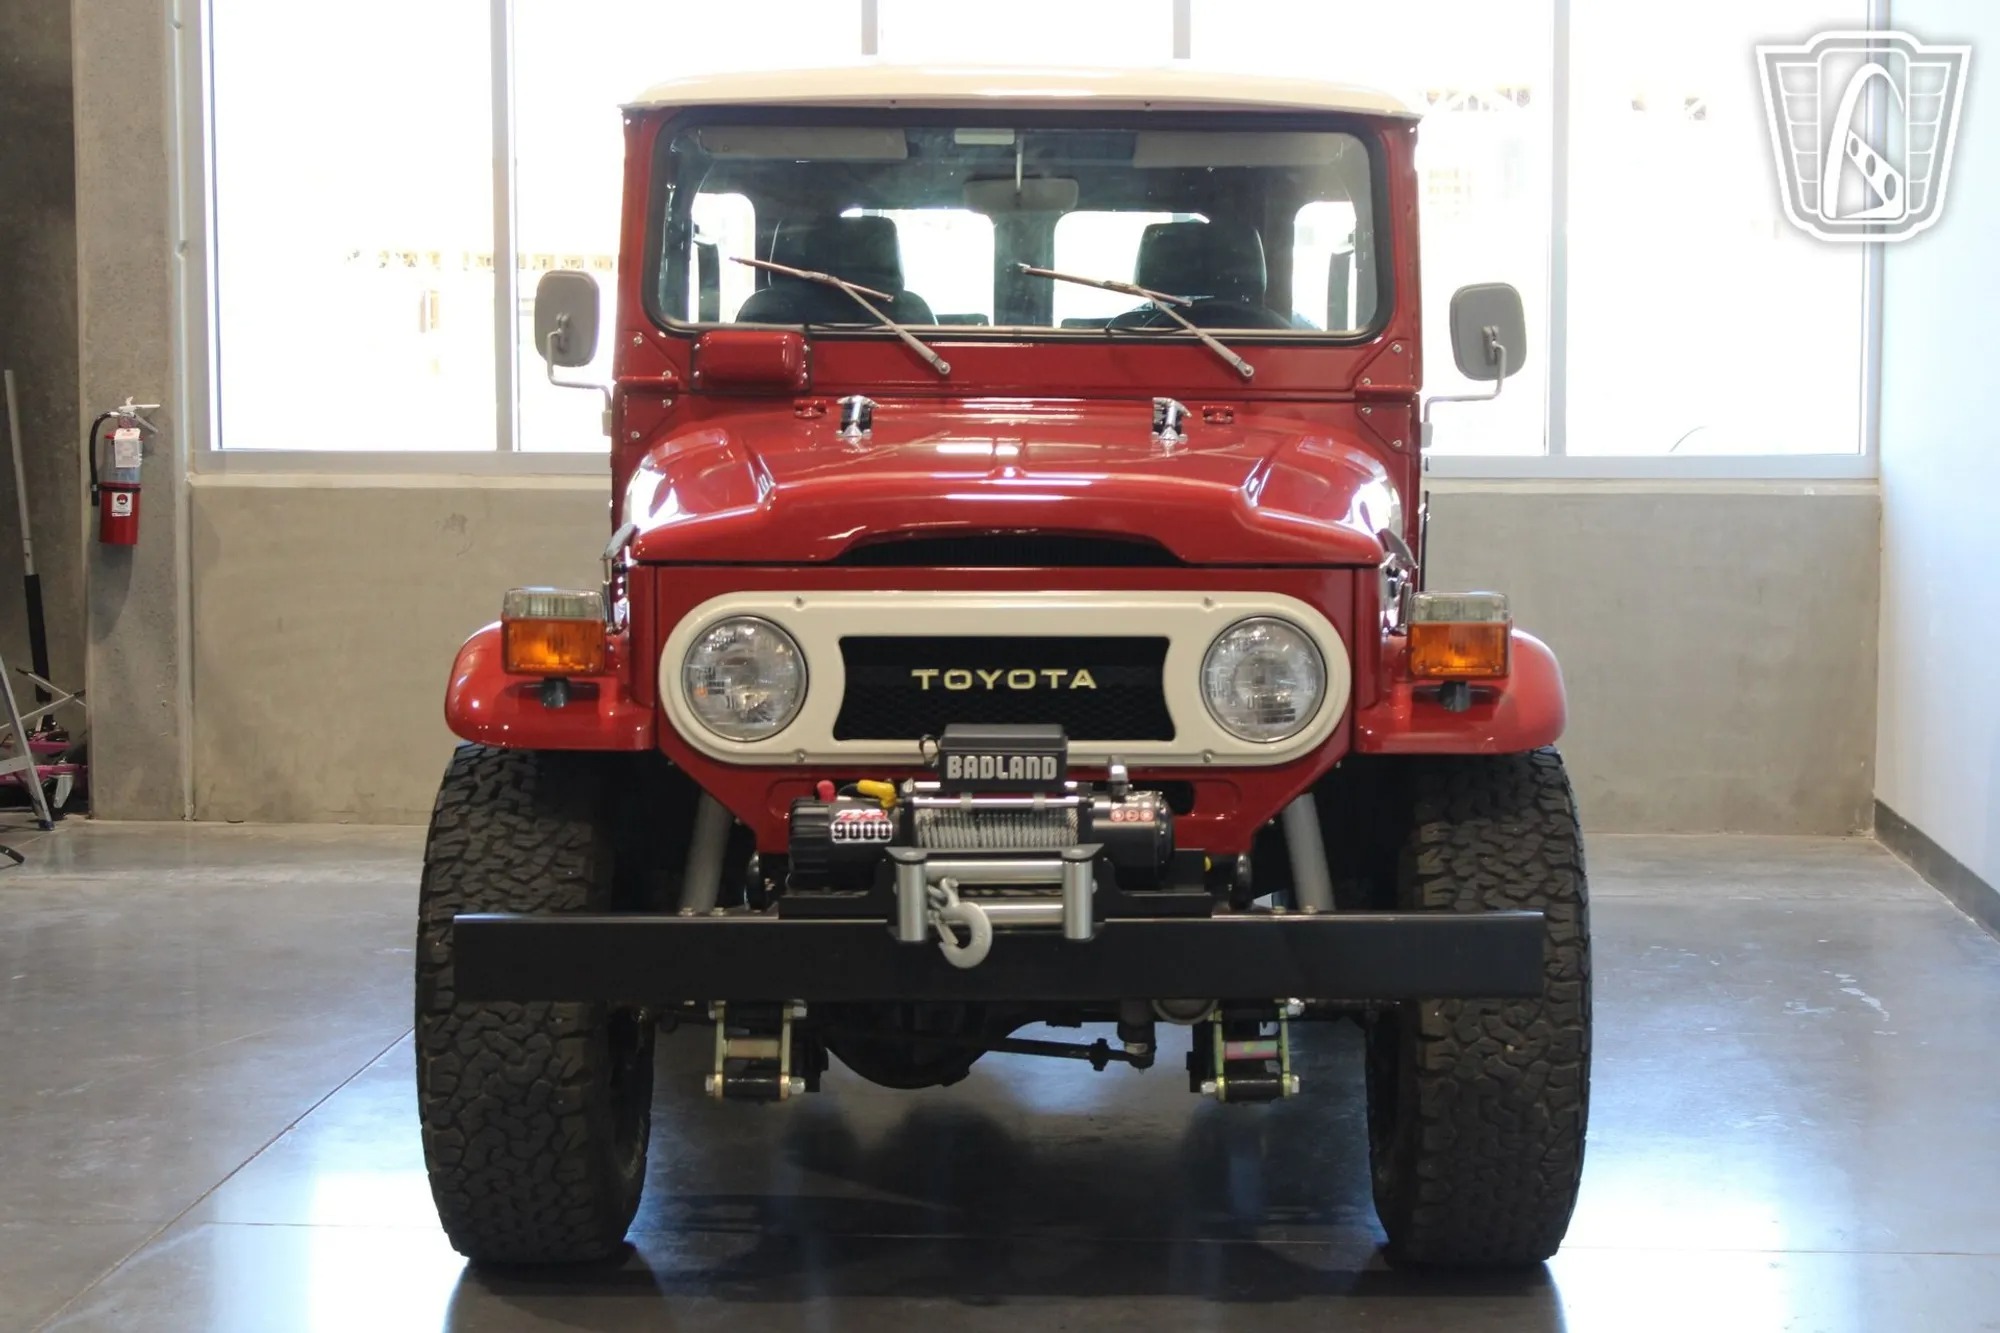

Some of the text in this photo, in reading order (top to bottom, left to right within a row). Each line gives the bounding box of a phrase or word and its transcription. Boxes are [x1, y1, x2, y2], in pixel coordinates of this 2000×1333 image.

[911, 669, 1097, 690] TOYOTA
[947, 756, 1058, 779] BADLAND
[834, 821, 890, 840] 9000
